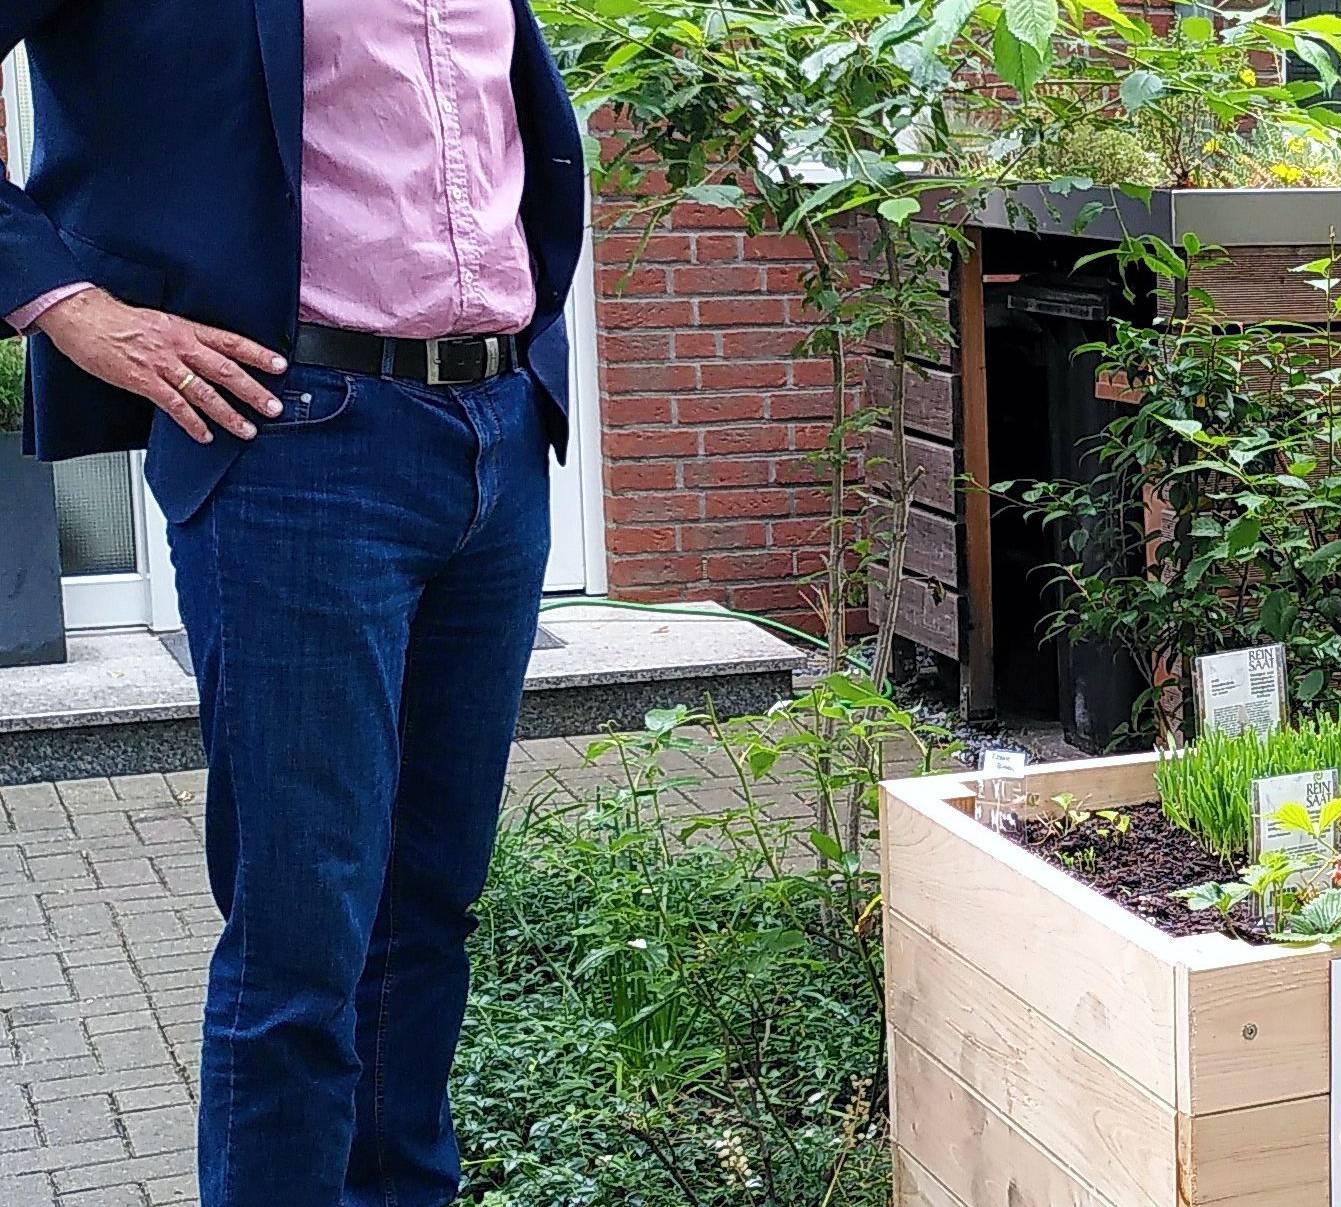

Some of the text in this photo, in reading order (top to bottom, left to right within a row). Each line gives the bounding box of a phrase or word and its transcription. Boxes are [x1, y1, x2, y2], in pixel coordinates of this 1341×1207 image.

[1249, 648, 1274, 660] REIN
[1249, 658, 1274, 671] SAAT
[1306, 781, 1332, 795] REIN
[1306, 793, 1332, 808] SAAT
